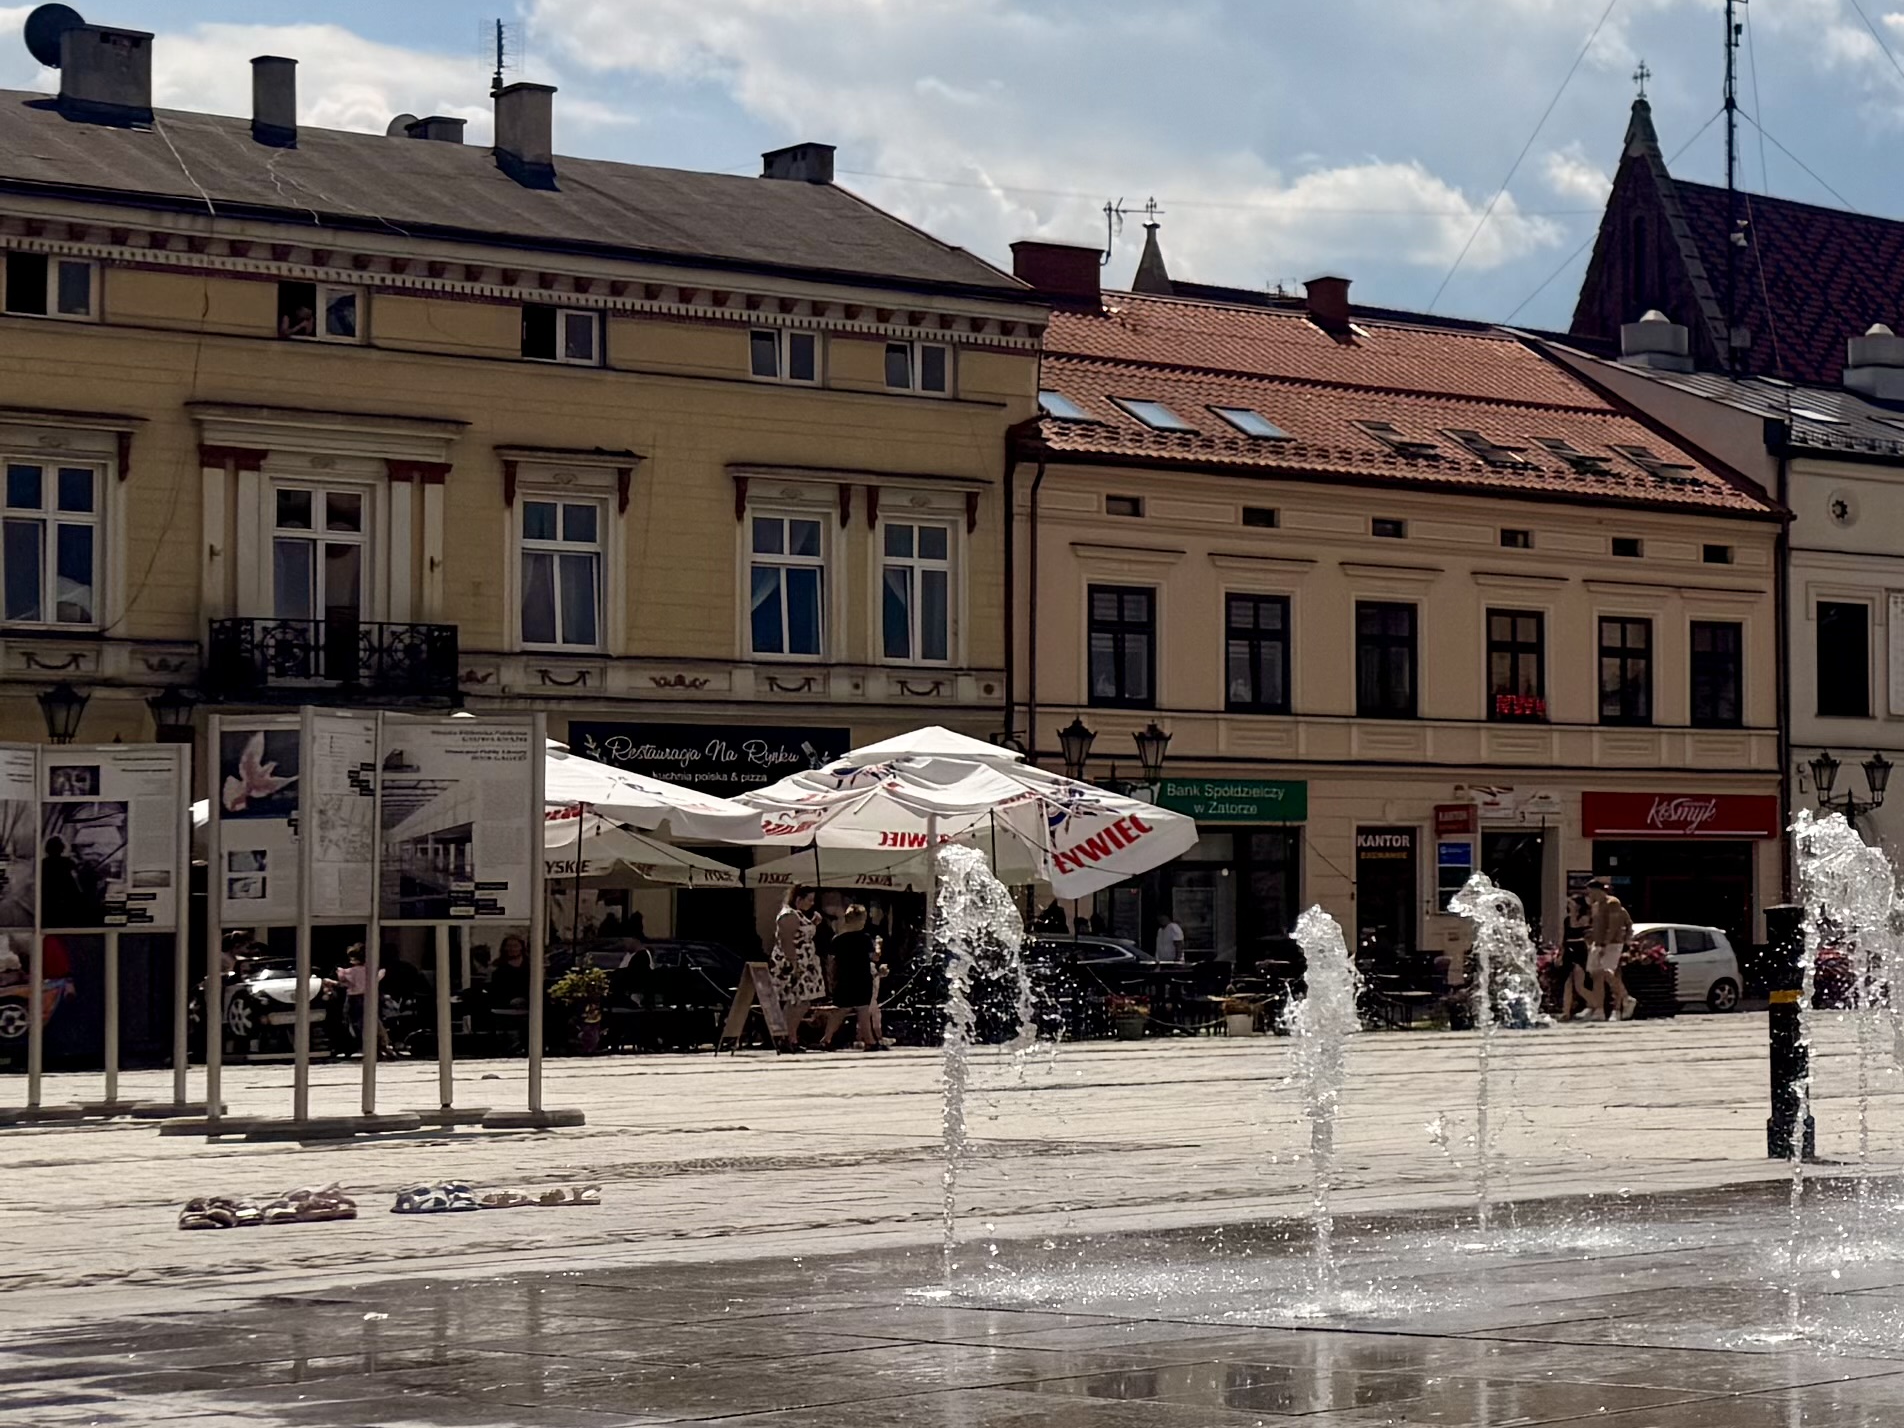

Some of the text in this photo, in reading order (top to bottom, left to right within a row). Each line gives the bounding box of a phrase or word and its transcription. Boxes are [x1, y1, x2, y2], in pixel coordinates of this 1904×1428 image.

[705, 739, 738, 762] Na
[742, 739, 799, 767] Rynku
[694, 772, 728, 783] polska
[741, 772, 768, 783] pizza
[1167, 783, 1285, 801] Bank Spółdzielczy
[1194, 801, 1258, 814] w Zatorze
[1357, 834, 1411, 847] KANTOR
[544, 860, 592, 874] YSKIE
